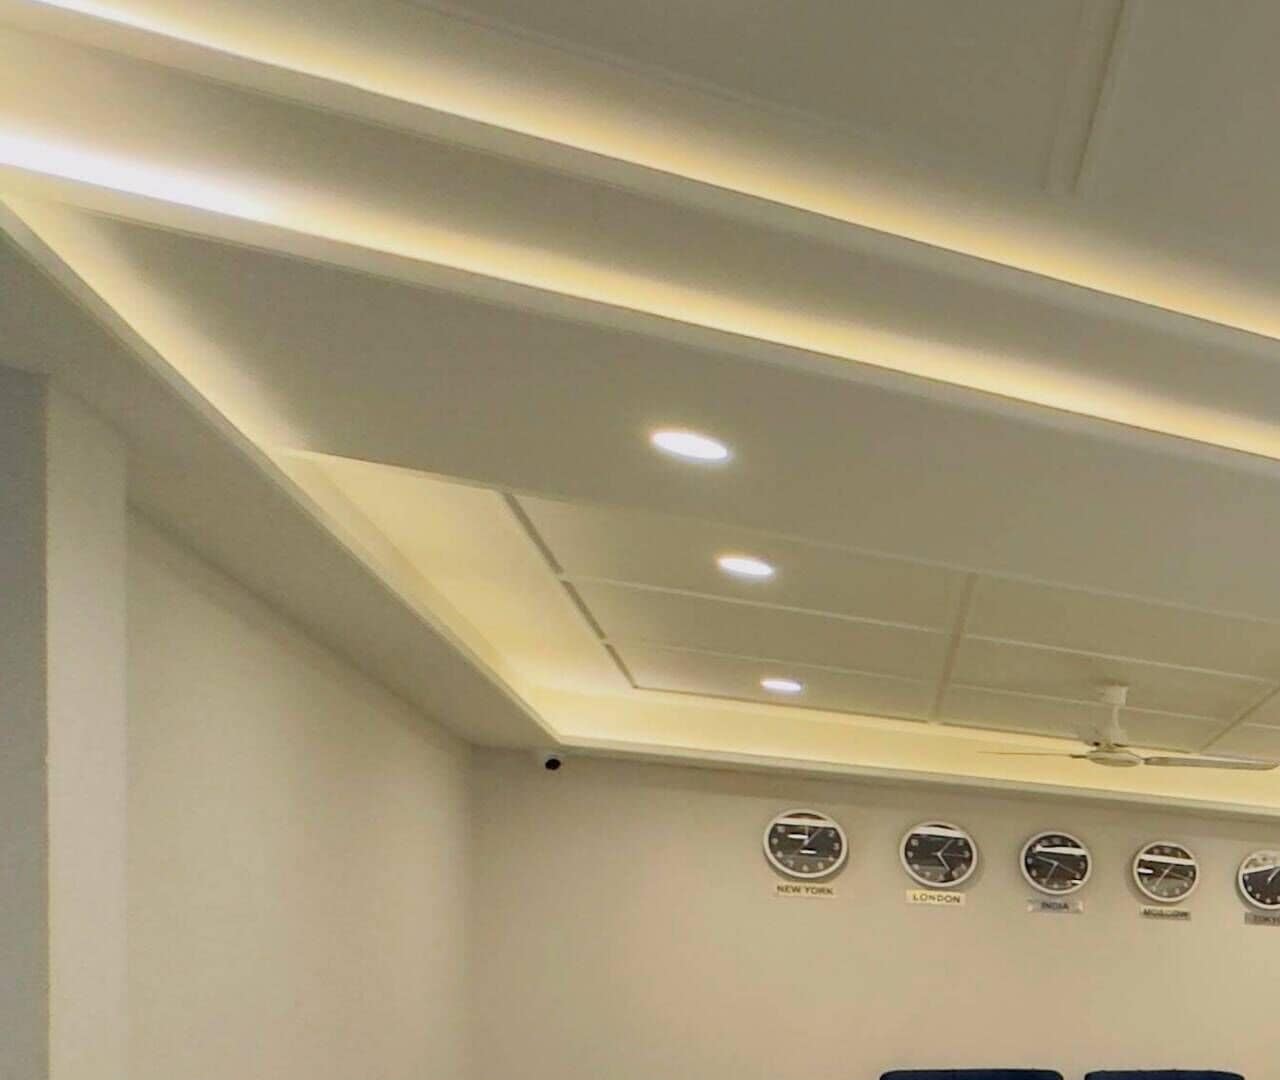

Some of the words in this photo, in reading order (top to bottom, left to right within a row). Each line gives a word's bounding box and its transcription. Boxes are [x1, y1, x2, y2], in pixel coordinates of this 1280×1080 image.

[777, 885, 800, 894] NEW
[804, 886, 833, 895] YORK
[912, 893, 960, 903] LONDON
